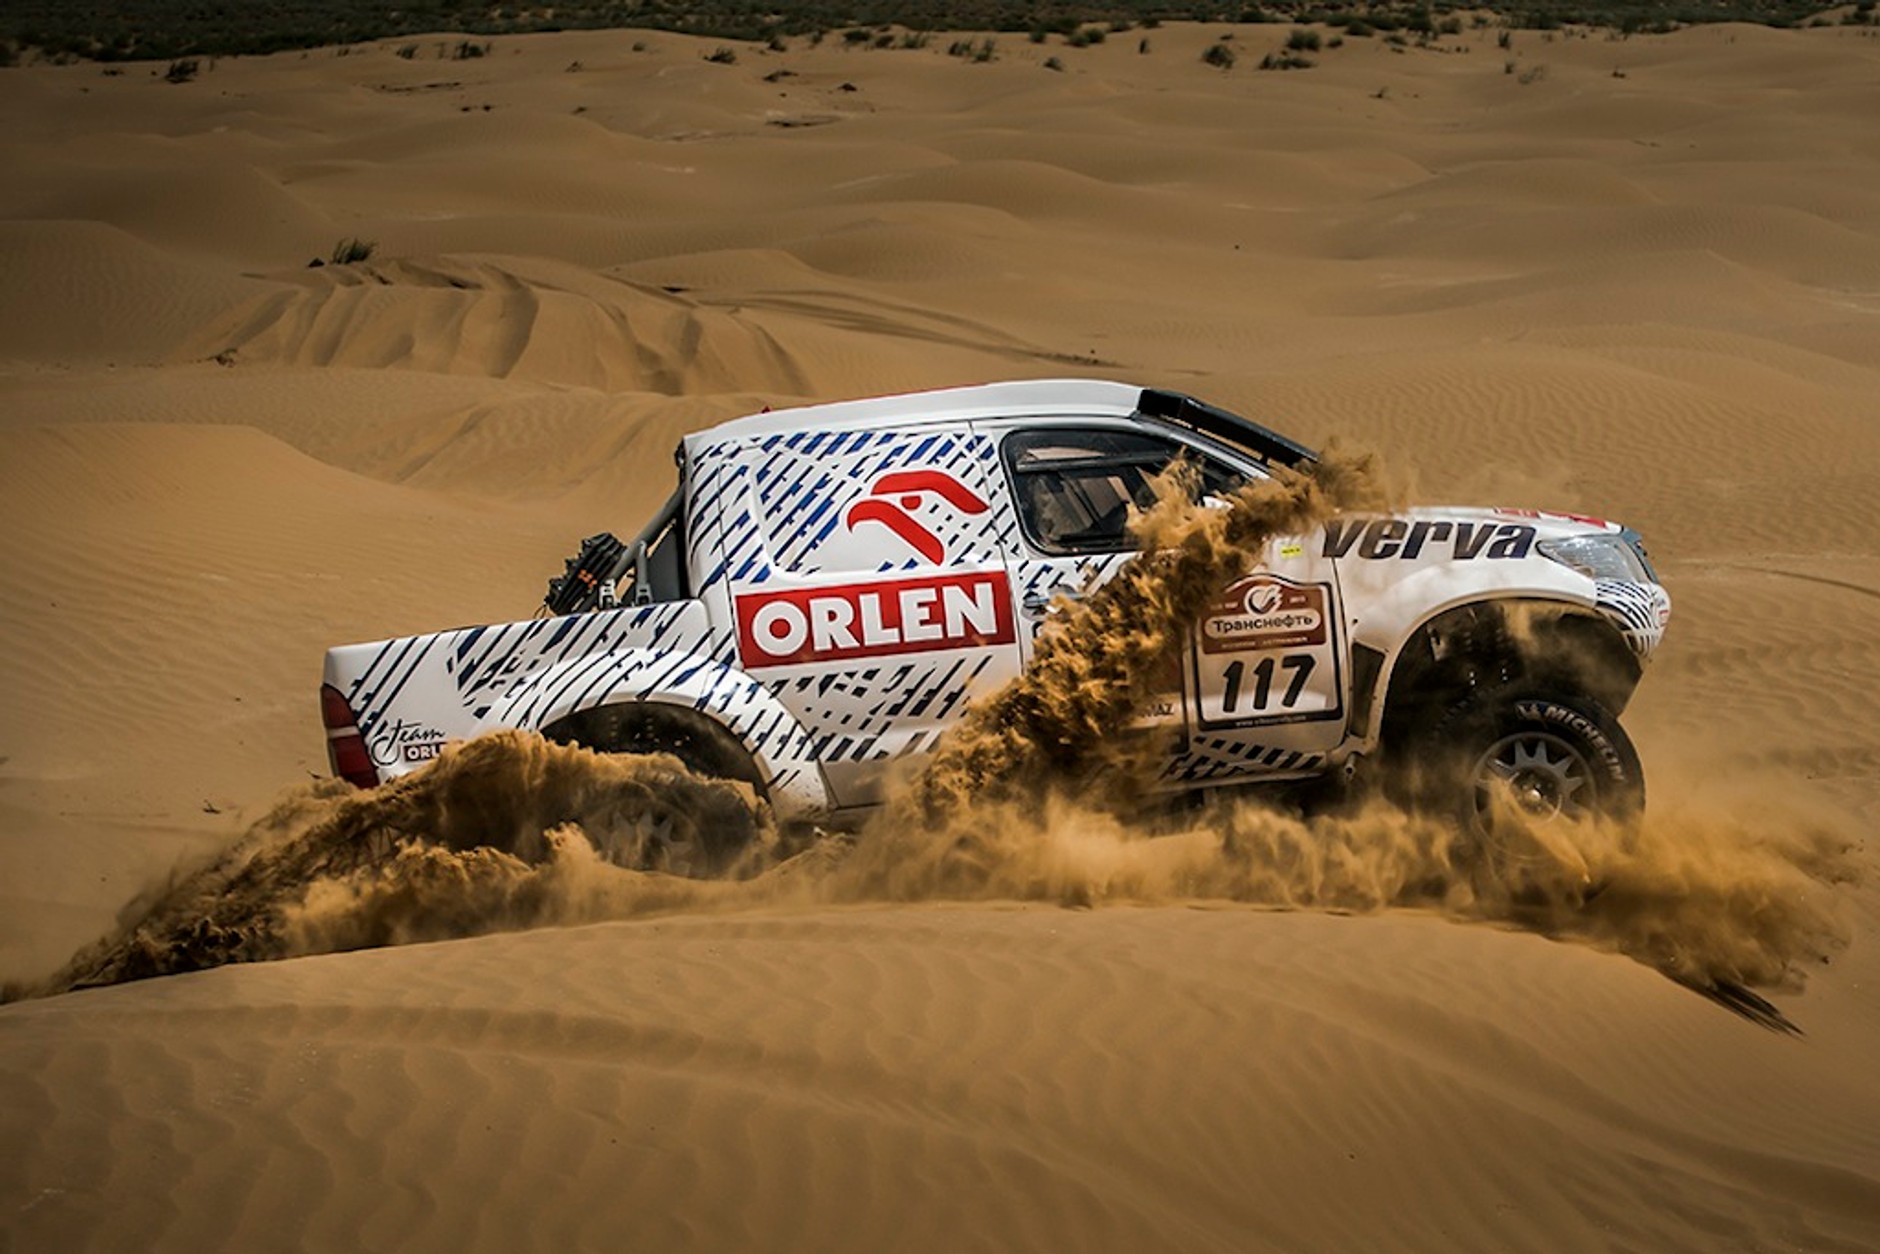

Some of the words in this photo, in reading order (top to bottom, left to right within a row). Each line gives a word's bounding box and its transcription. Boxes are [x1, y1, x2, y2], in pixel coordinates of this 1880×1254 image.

[1321, 519, 1538, 560] verva
[752, 582, 998, 656] ORLEN
[1213, 614, 1313, 633] Транснефть
[1222, 653, 1317, 713] 117
[407, 744, 441, 760] ORL
[1544, 705, 1626, 781] MICHELIN
